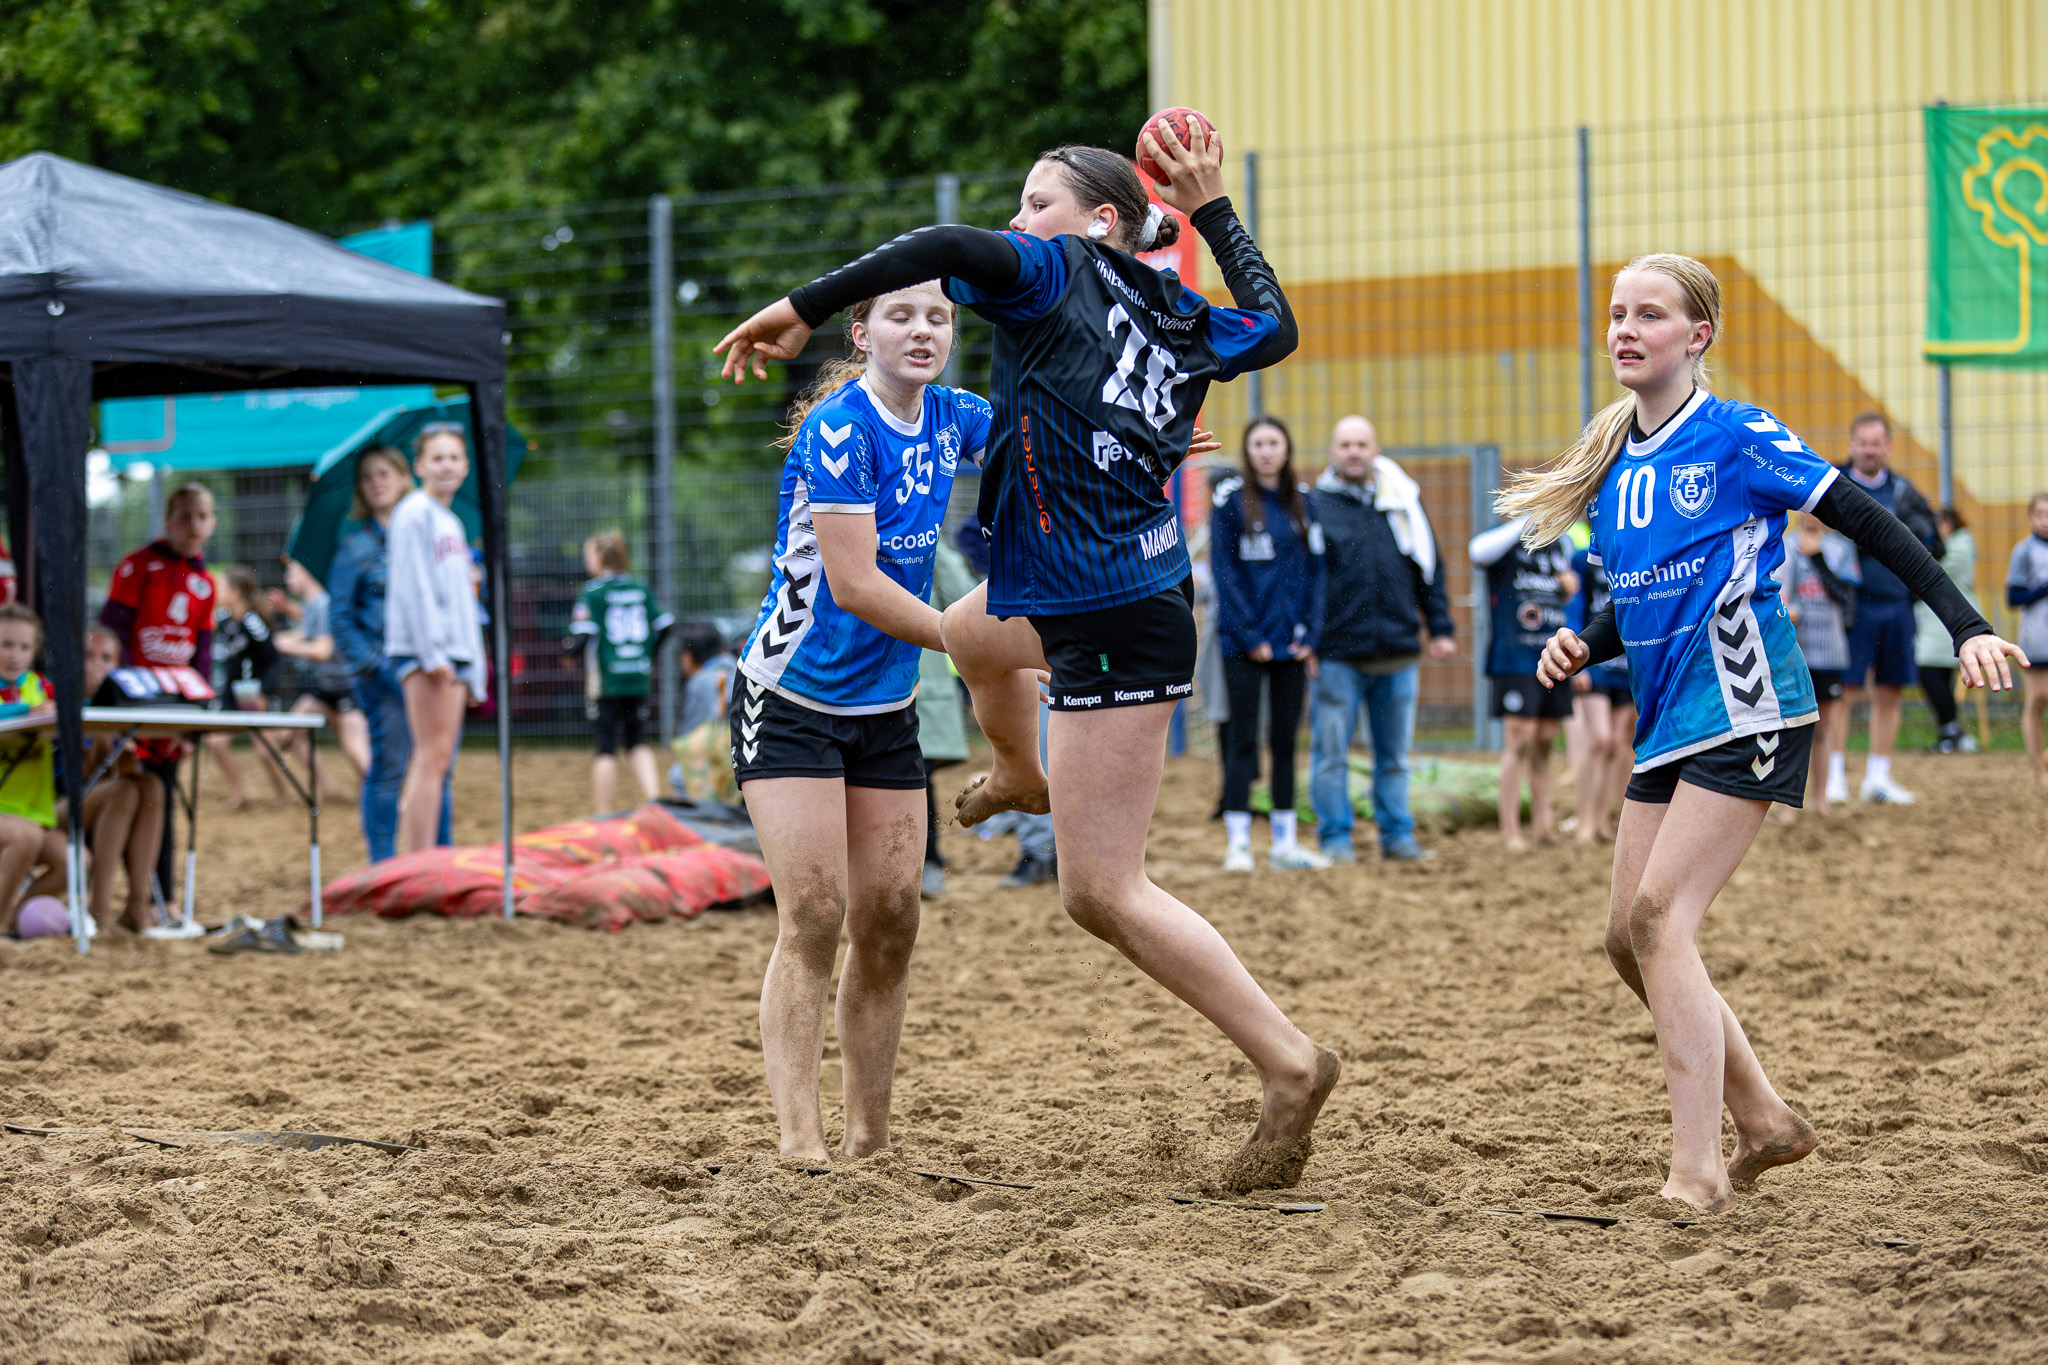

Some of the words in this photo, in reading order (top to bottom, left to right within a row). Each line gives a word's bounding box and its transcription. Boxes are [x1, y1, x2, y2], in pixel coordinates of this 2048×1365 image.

[895, 442, 934, 506] 35
[1741, 444, 1774, 469] Sony's
[1615, 464, 1656, 531] 10
[1063, 695, 1102, 707] Kempa
[1114, 689, 1154, 702] Kempa
[1165, 682, 1192, 696] Kempa
